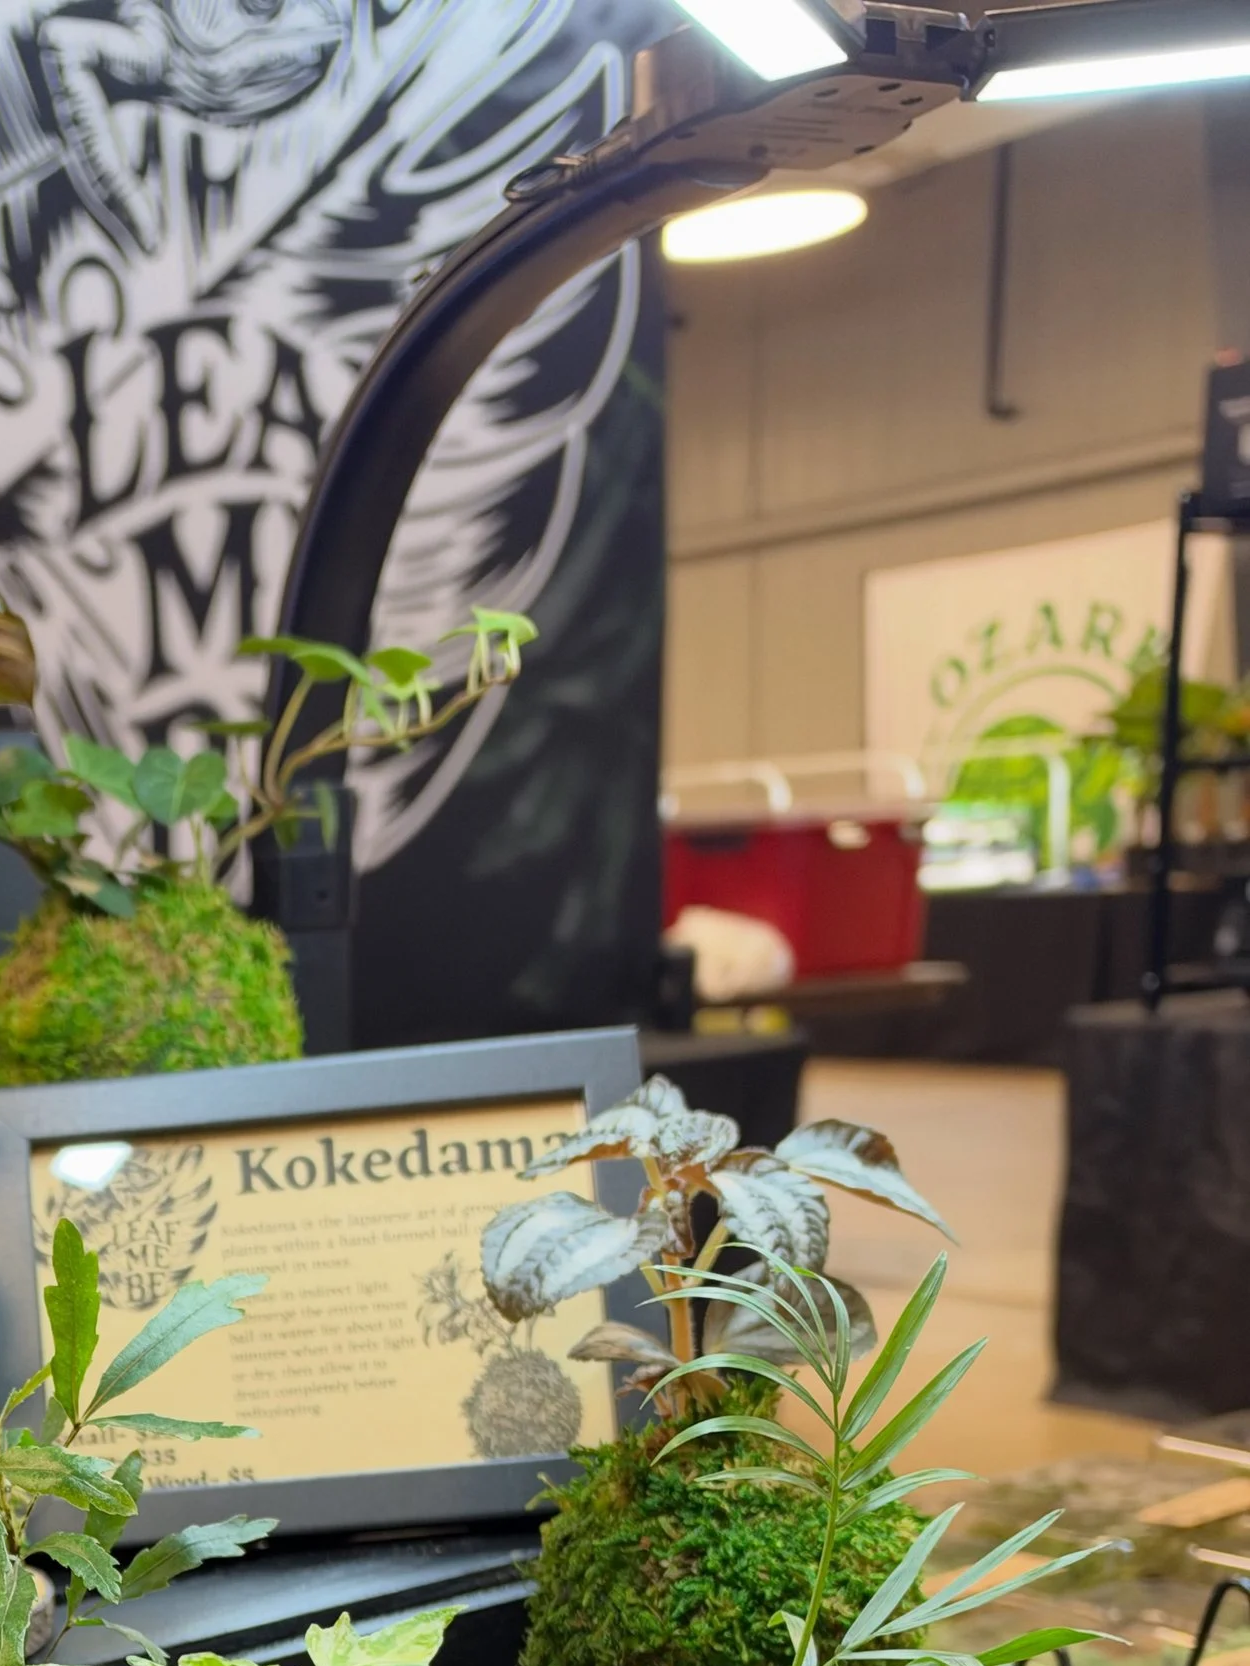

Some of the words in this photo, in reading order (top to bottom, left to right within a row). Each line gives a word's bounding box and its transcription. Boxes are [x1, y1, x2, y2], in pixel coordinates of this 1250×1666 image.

[59, 316, 322, 532] LEA
[112, 1220, 180, 1250] LEAF
[126, 1245, 170, 1271] ME
[127, 1271, 166, 1304] BE
